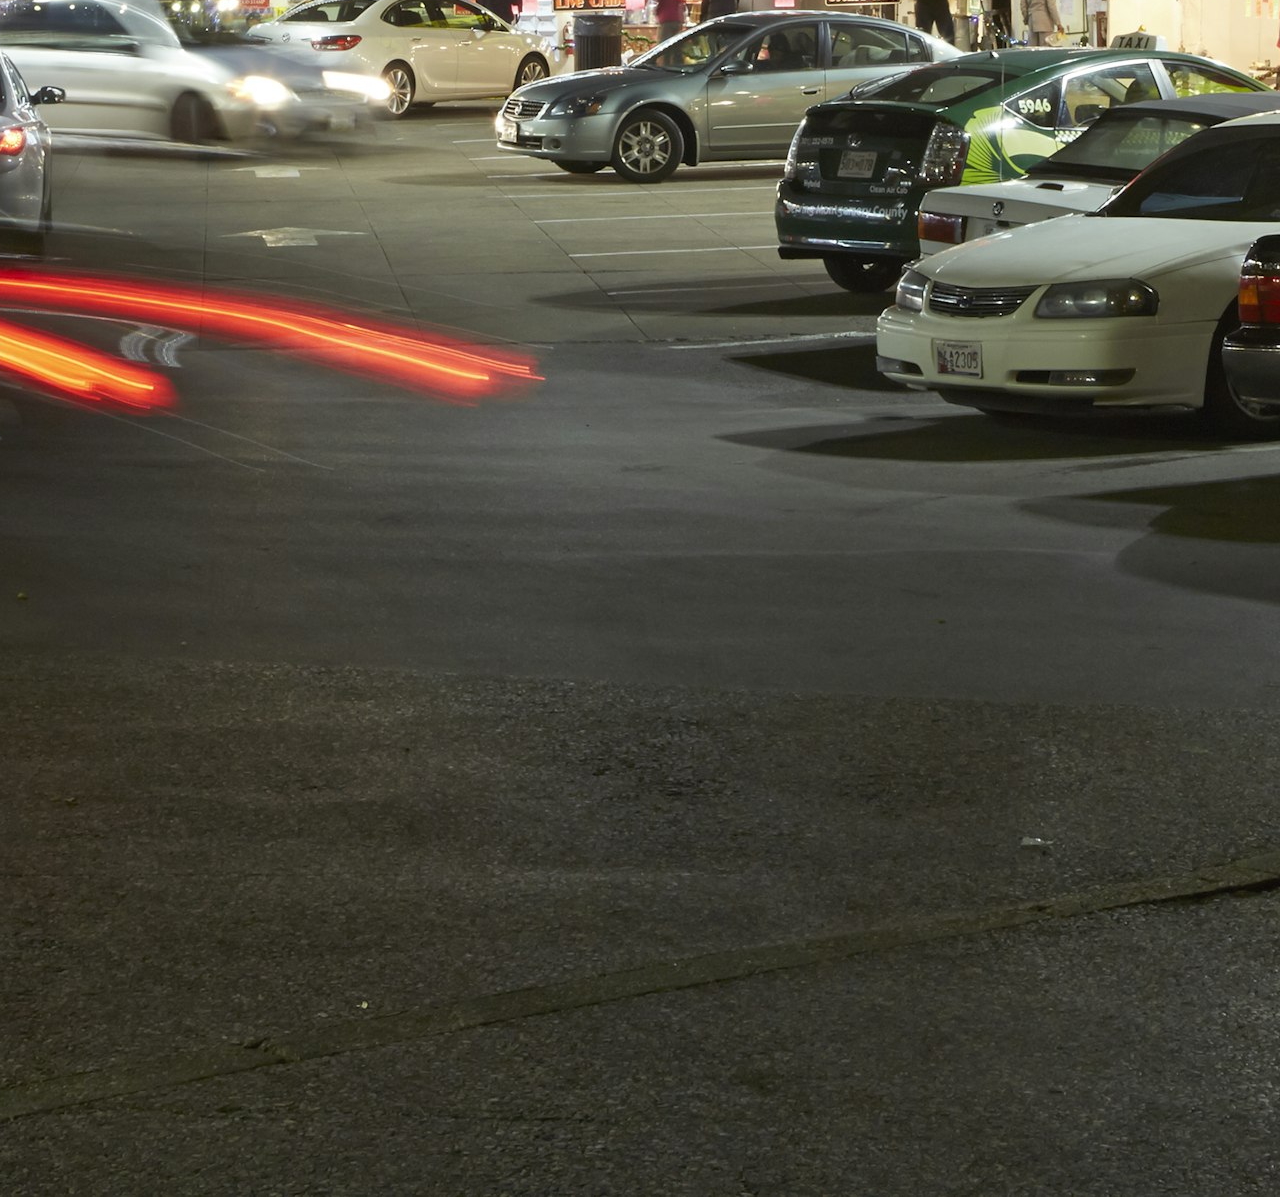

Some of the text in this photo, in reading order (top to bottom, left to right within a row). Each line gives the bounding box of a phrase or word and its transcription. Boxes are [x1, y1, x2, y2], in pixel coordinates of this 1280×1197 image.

[1118, 36, 1150, 49] TAXI
[1018, 97, 1052, 115] 5946
[869, 185, 909, 195] Clean Air Cab
[815, 204, 872, 219] Montgomery
[872, 205, 909, 221] County
